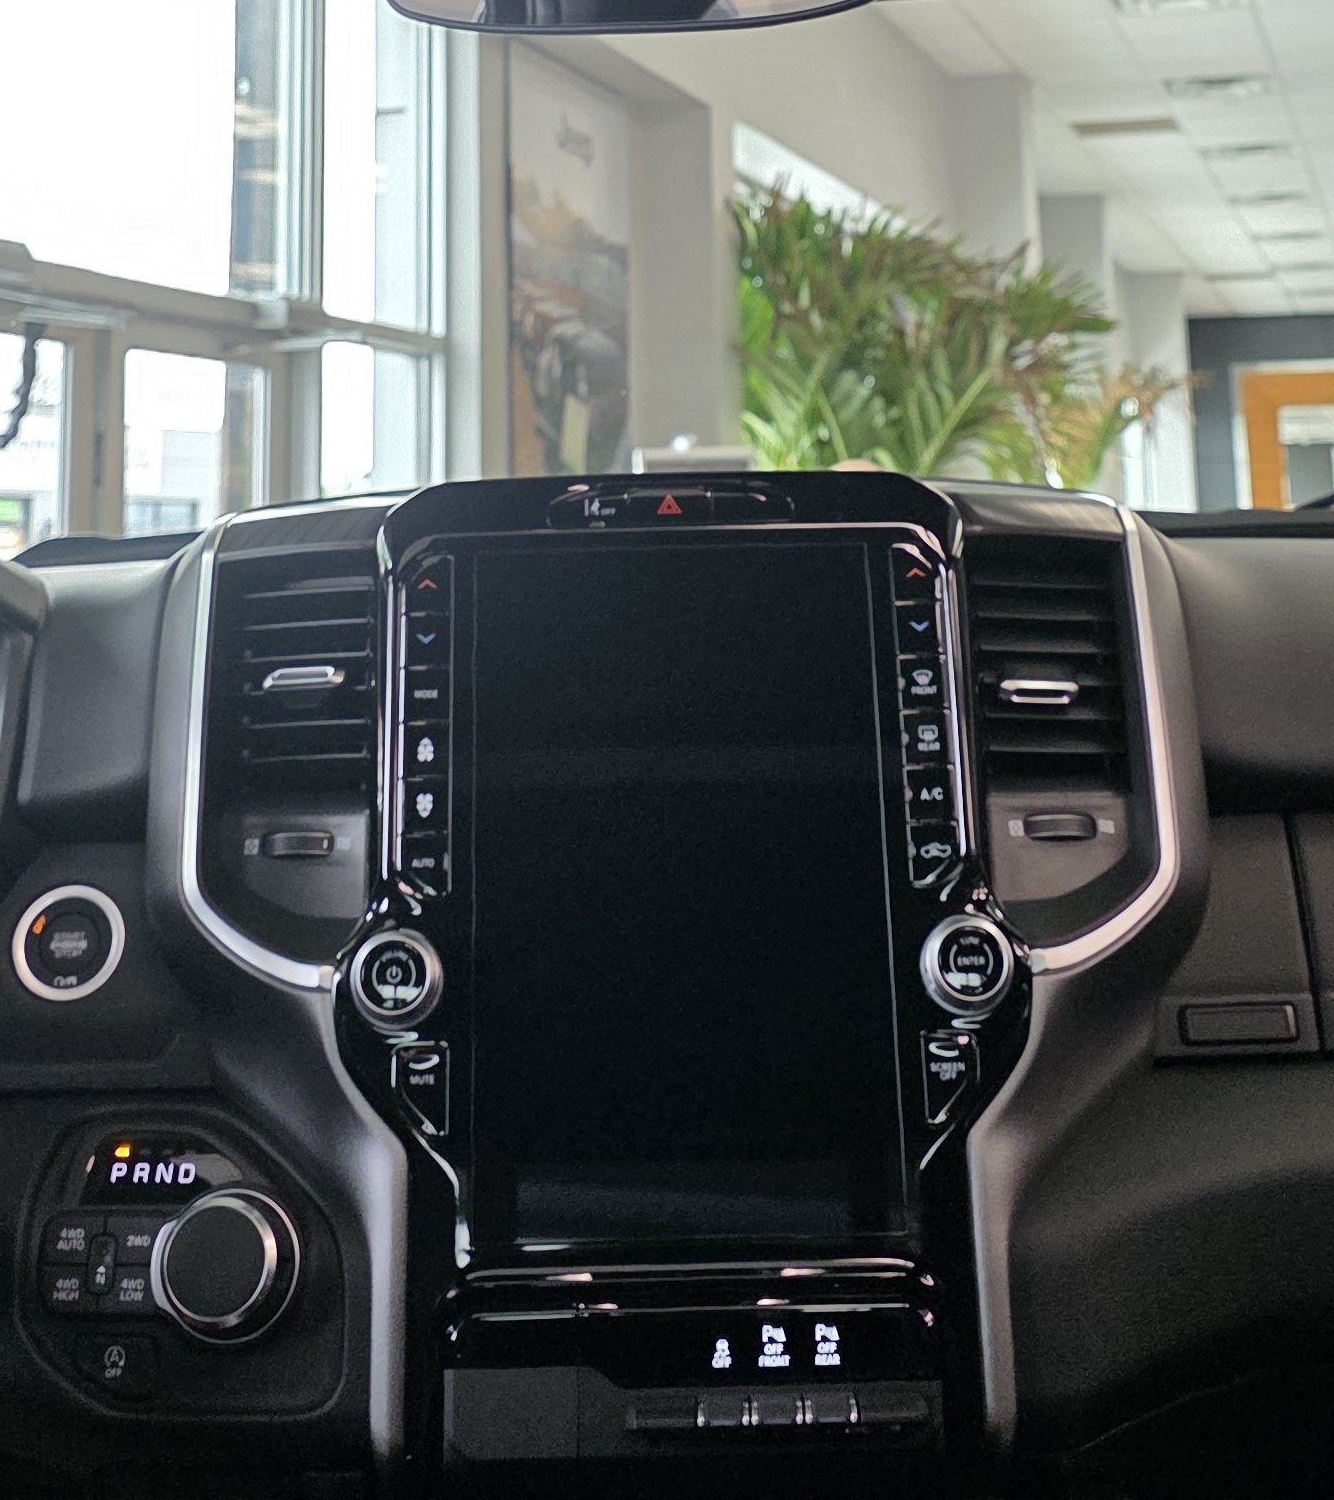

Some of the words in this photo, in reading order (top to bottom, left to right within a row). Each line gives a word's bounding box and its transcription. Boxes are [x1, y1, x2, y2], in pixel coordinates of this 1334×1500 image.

[920, 786, 944, 800] A/C
[411, 858, 435, 869] AUTO
[930, 1061, 966, 1073] SCREEN
[409, 1074, 436, 1086] MUTE
[60, 1228, 85, 1239] 4WD
[56, 1239, 85, 1250] AUTO
[126, 1235, 151, 1247] 2WD
[55, 1278, 80, 1290] 4WD
[120, 1278, 145, 1290] 4WD
[119, 1289, 145, 1301] LOW
[764, 1342, 784, 1355] OFF
[817, 1341, 837, 1354] OFF
[712, 1356, 732, 1368] OFF
